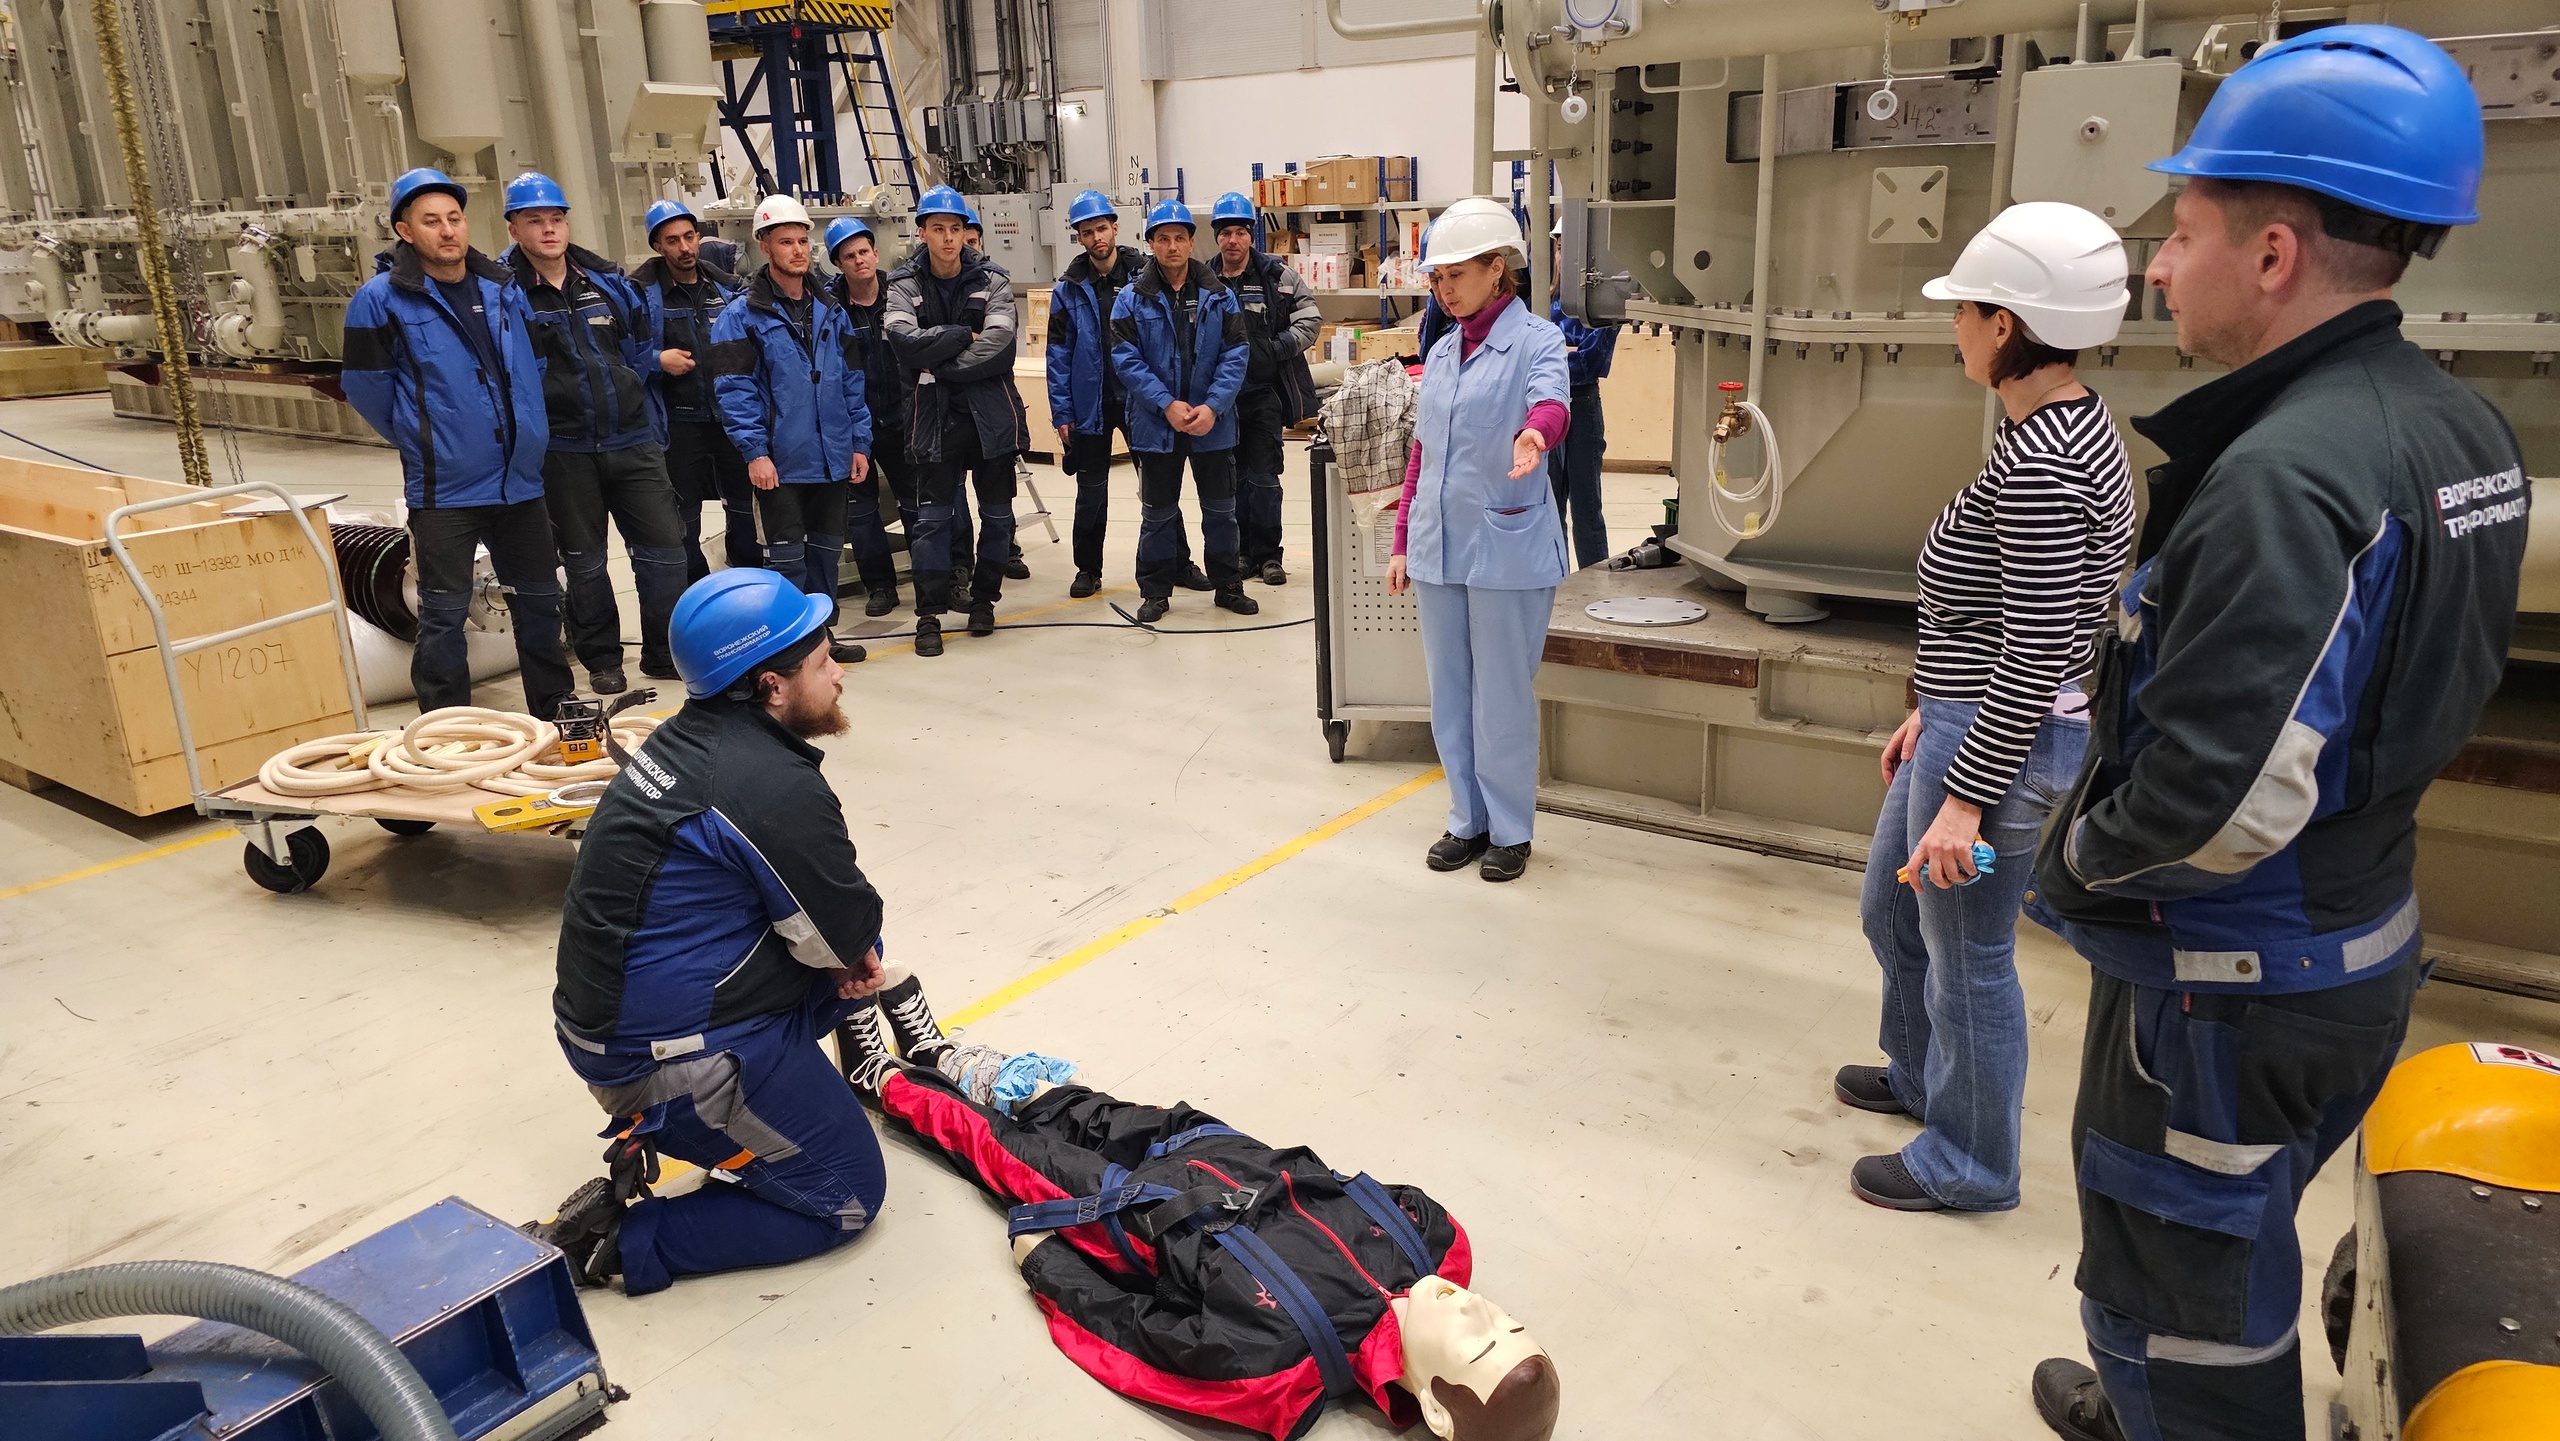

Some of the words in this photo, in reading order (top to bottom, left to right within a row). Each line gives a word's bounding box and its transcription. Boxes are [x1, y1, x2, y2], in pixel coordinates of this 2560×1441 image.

[1130, 155, 1139, 168] N
[1128, 172, 1144, 186] 8/
[713, 624, 769, 656] ВОРОНЕЖСКИЙ
[716, 630, 771, 661] ТРАНСФОРМАТОР
